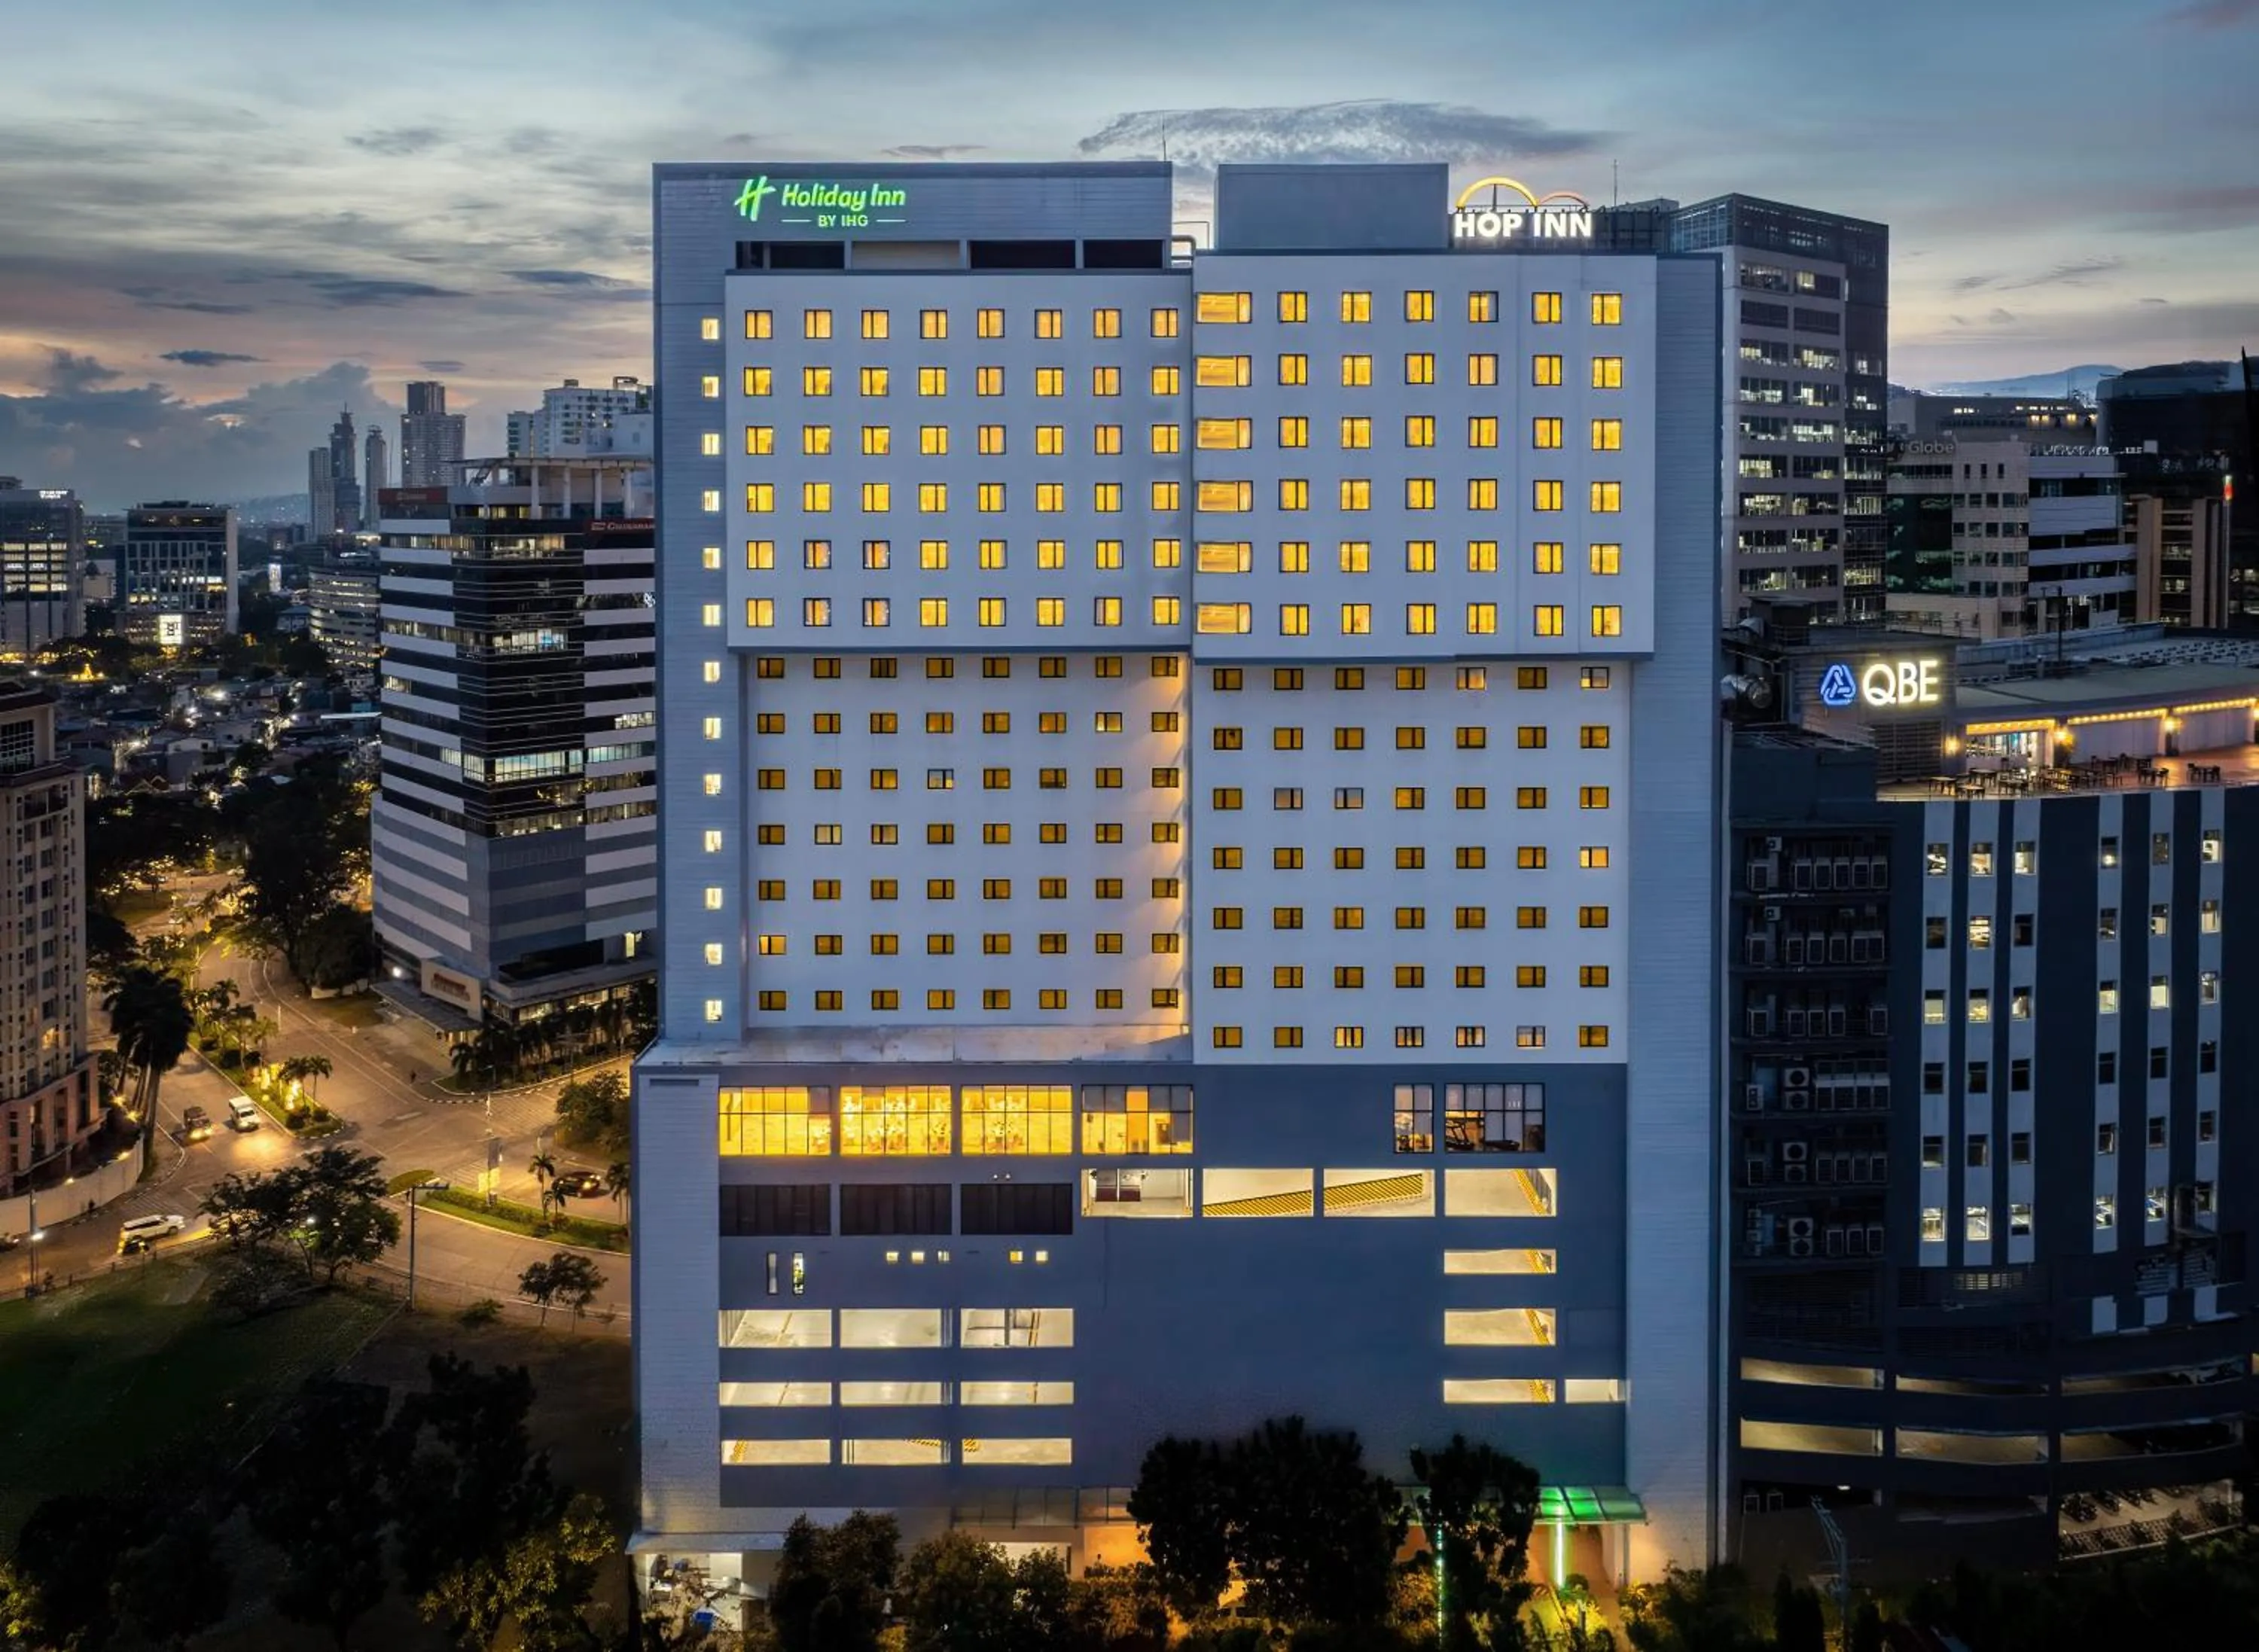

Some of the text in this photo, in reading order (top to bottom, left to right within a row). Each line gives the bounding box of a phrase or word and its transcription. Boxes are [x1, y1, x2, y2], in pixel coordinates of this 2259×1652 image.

[781, 183, 906, 212] Holiday Inn
[818, 215, 868, 227] BY IHG
[1454, 212, 1592, 238] HOP INN
[1908, 440, 1954, 454] Globe
[1862, 660, 1939, 706] QBE
